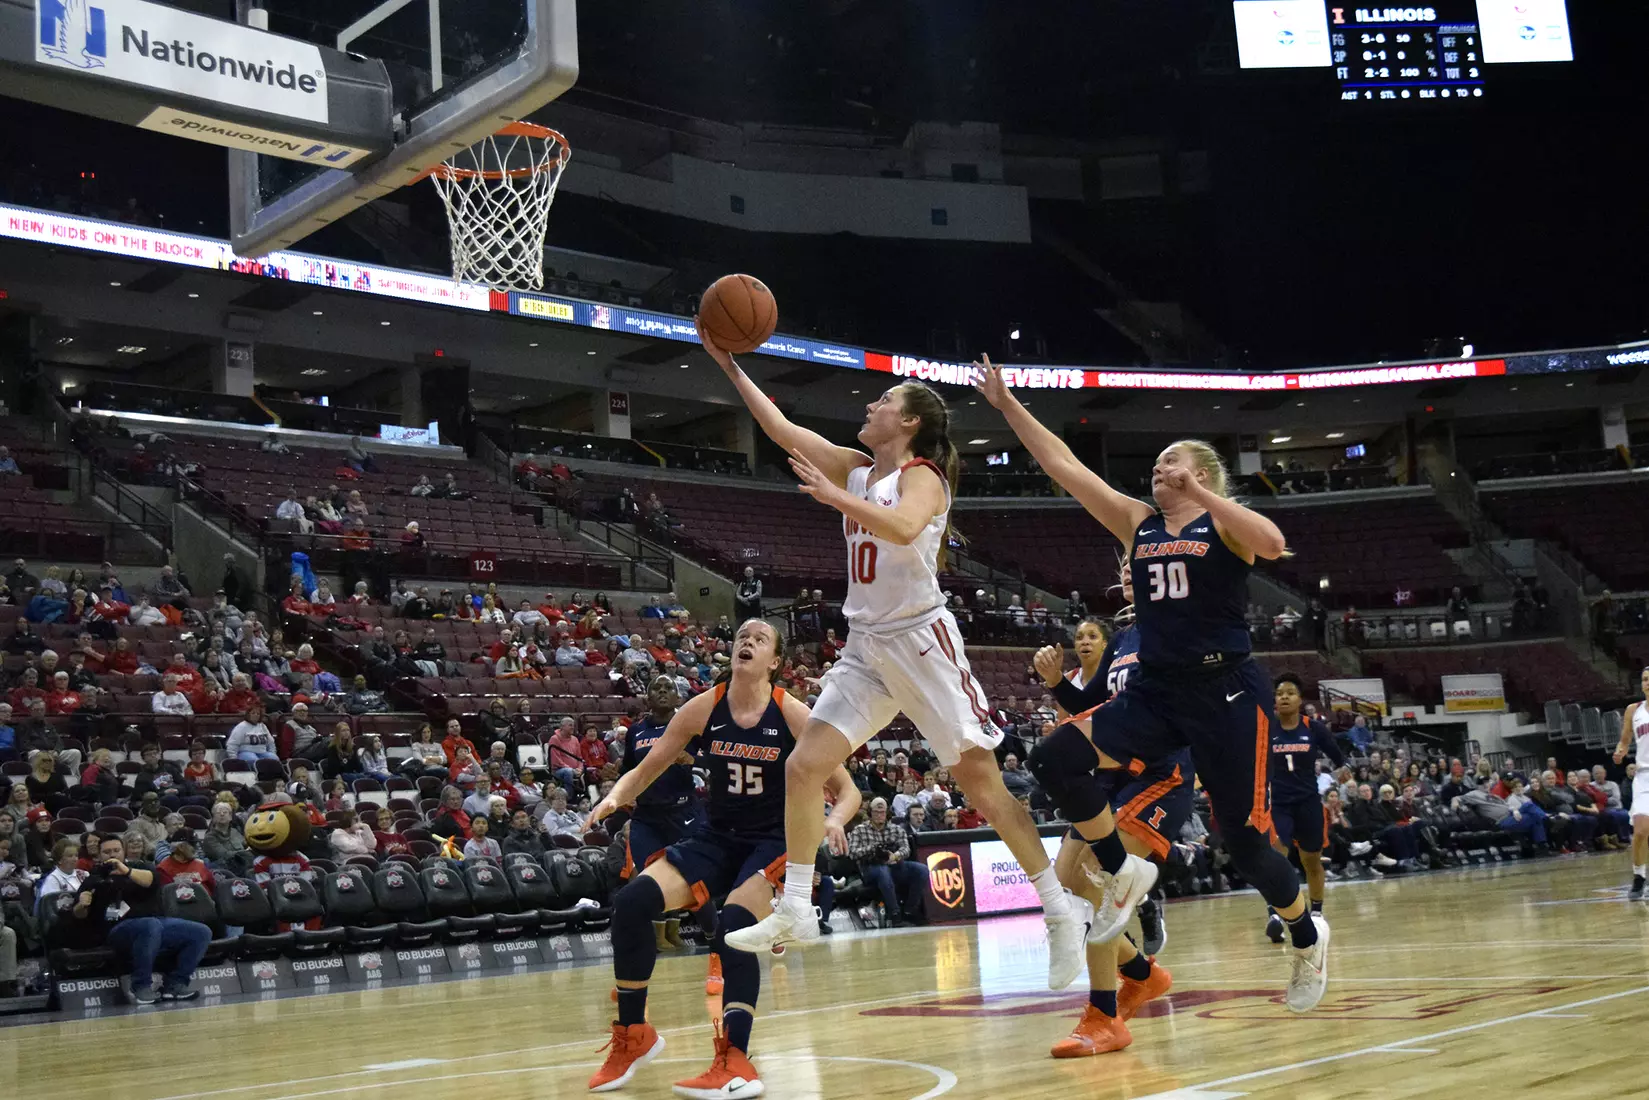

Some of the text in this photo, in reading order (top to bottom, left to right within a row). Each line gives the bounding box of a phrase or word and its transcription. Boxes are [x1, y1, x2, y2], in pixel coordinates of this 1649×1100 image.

[1355, 8, 1437, 23] ILLINOIS
[1332, 34, 1346, 46] FG
[1396, 34, 1411, 43] 50
[1466, 37, 1474, 46] 1
[121, 25, 318, 94] Nationwide
[1333, 51, 1346, 62] 3P
[1467, 52, 1476, 61] 2
[1336, 67, 1349, 79] FT
[1364, 67, 1390, 78] 2-2
[1400, 68, 1420, 77] 100
[1341, 91, 1358, 100] AST
[1364, 90, 1373, 100] 1
[1380, 90, 1397, 99] STL
[1419, 89, 1437, 99] BLK
[1456, 88, 1469, 98] TO
[170, 117, 301, 151] Nationwide
[9, 217, 204, 259] NEW KIDS ON THE BLOCK
[892, 355, 1084, 389] UPCOMIN EVENTS
[1135, 540, 1210, 560] ILLINOIS
[474, 559, 494, 572] 123
[851, 541, 877, 584] 10
[1148, 561, 1189, 601] 30
[710, 740, 781, 762] ILLINOIS
[1285, 754, 1294, 771] 1
[727, 762, 764, 795] 35
[1148, 806, 1167, 830] I
[991, 861, 1021, 873] PROUD
[931, 868, 962, 899] ups
[993, 873, 1017, 886] OHIO
[581, 934, 593, 943] GO
[493, 943, 507, 953] GO
[507, 940, 538, 951] BUCKS!
[396, 951, 411, 961] GO
[412, 948, 445, 960] BUCKS!
[293, 958, 343, 971] GO BUCKS!
[198, 967, 237, 979] BUCKS!
[59, 979, 120, 993] GO BUCKS!
[204, 984, 221, 995] AA3
[260, 979, 276, 988] AA4
[84, 996, 101, 1007] AA1
